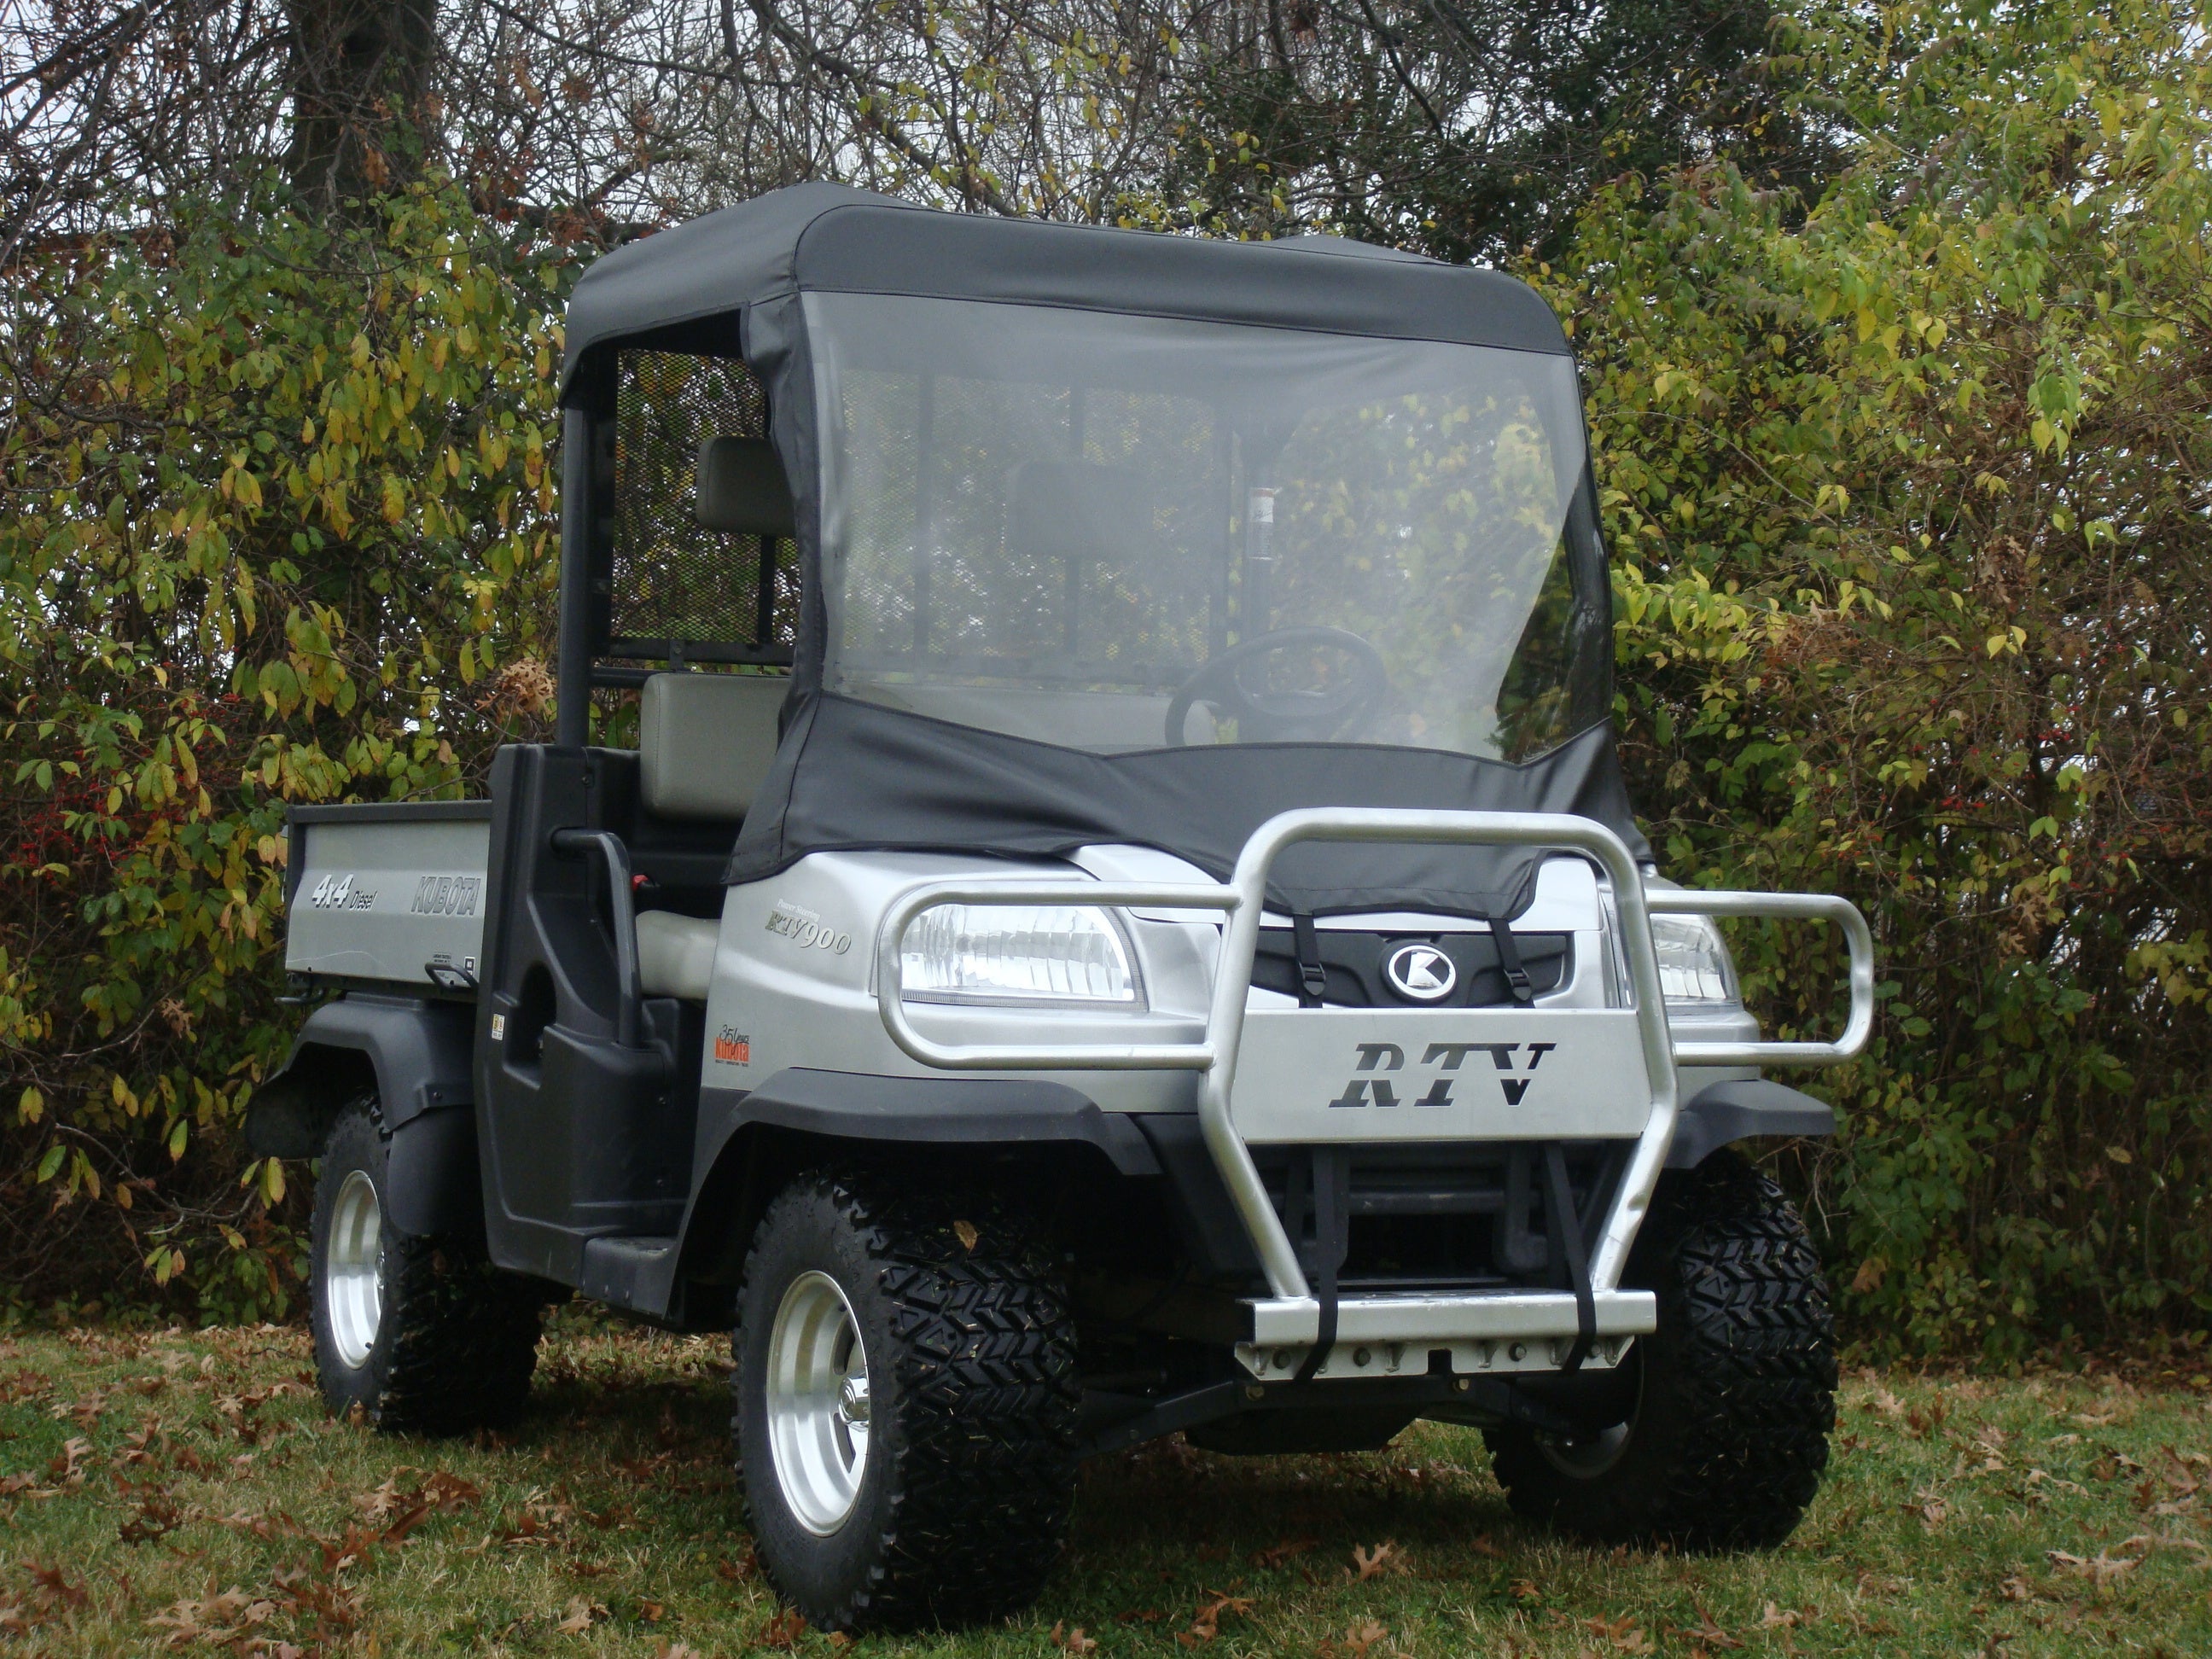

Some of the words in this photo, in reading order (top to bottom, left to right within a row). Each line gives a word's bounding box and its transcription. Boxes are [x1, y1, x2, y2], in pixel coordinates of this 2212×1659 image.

[312, 873, 354, 909] 4x4
[348, 889, 378, 911] Diesel
[410, 876, 481, 916] KUBOTA
[765, 909, 852, 955] RTV900
[1328, 1042, 1557, 1108] RTV
